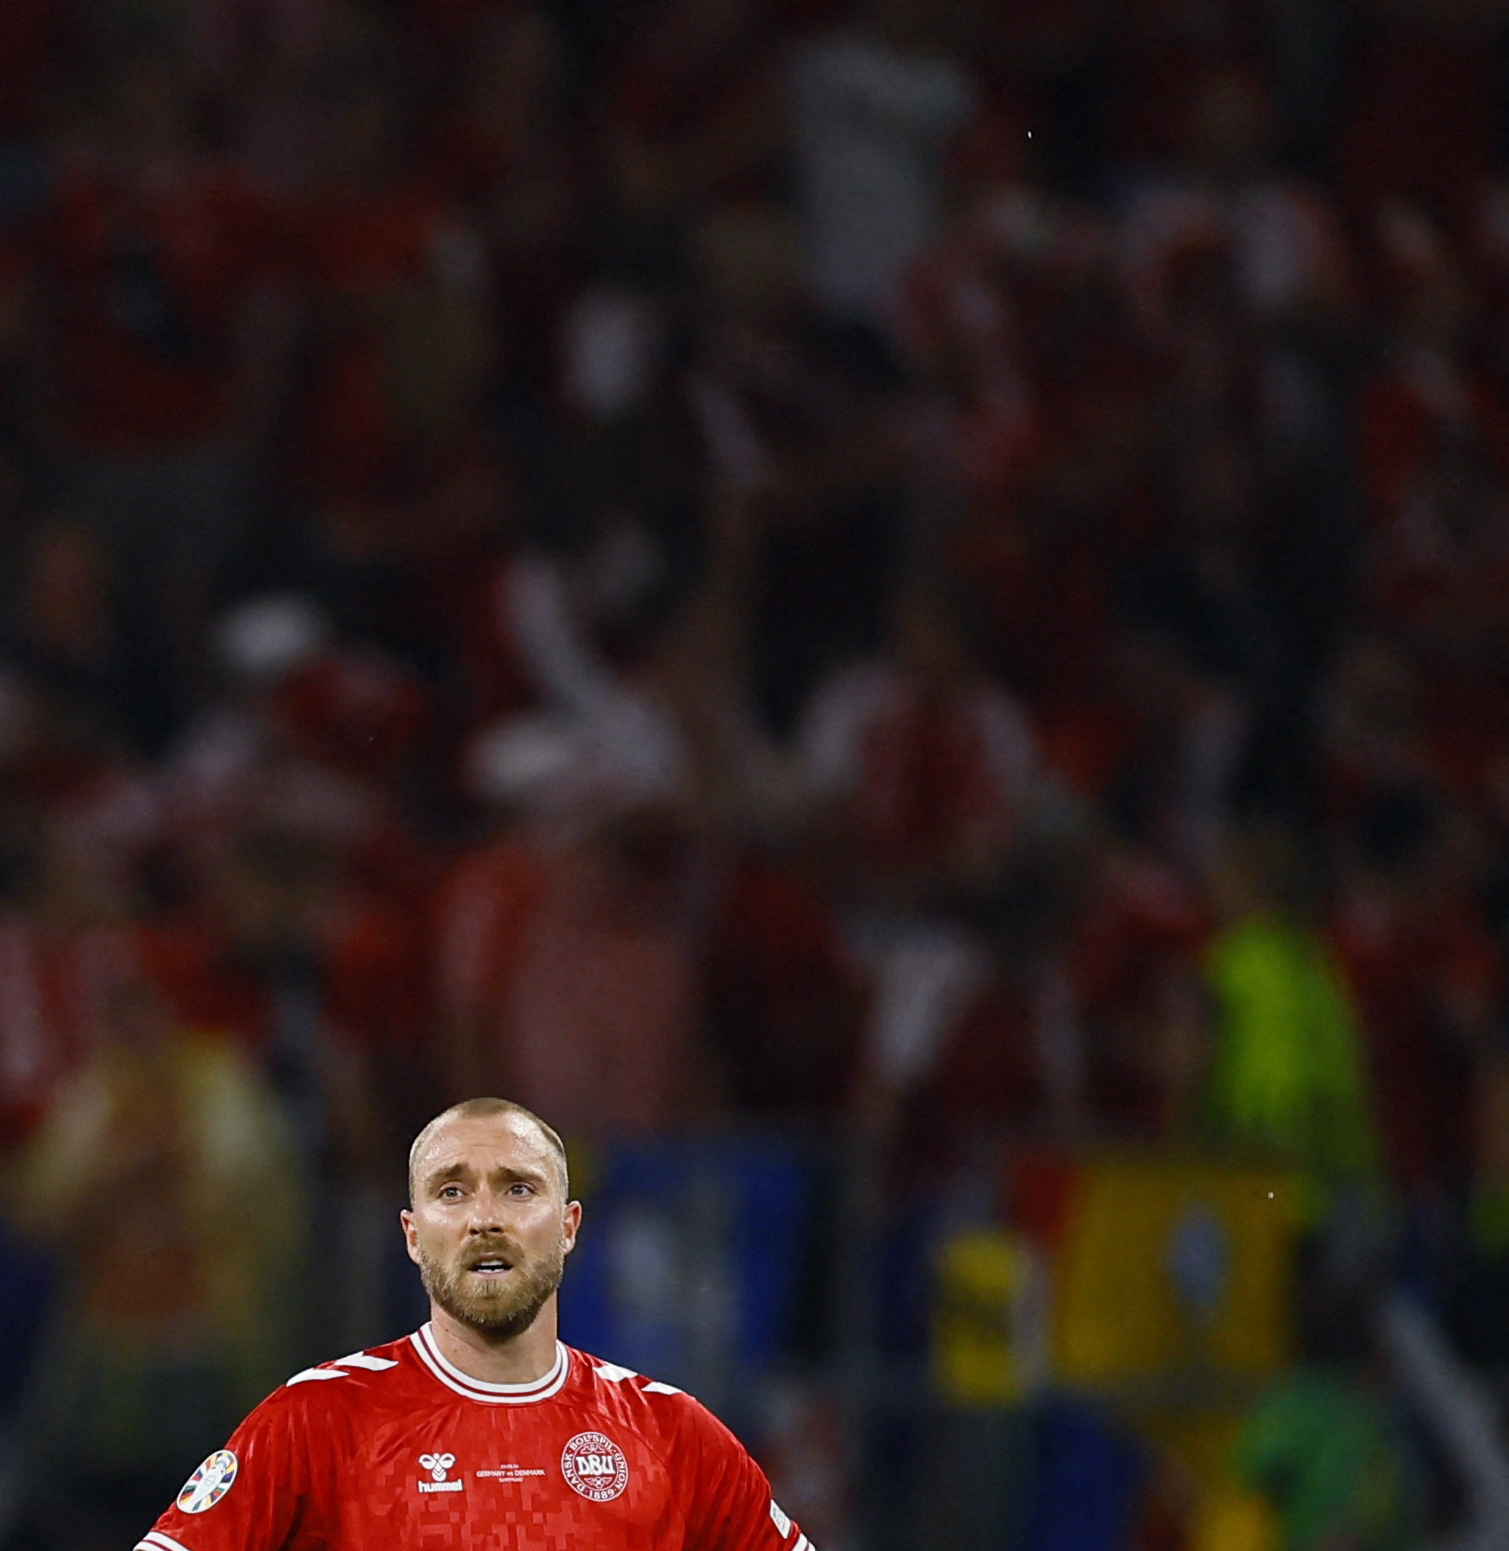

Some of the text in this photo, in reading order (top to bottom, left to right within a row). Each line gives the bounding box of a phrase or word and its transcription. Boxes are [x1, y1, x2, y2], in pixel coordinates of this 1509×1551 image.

[563, 1453, 586, 1492] DANSK
[589, 1488, 615, 1499] 1889
[575, 1454, 616, 1476] DBU
[418, 1478, 463, 1493] hummel
